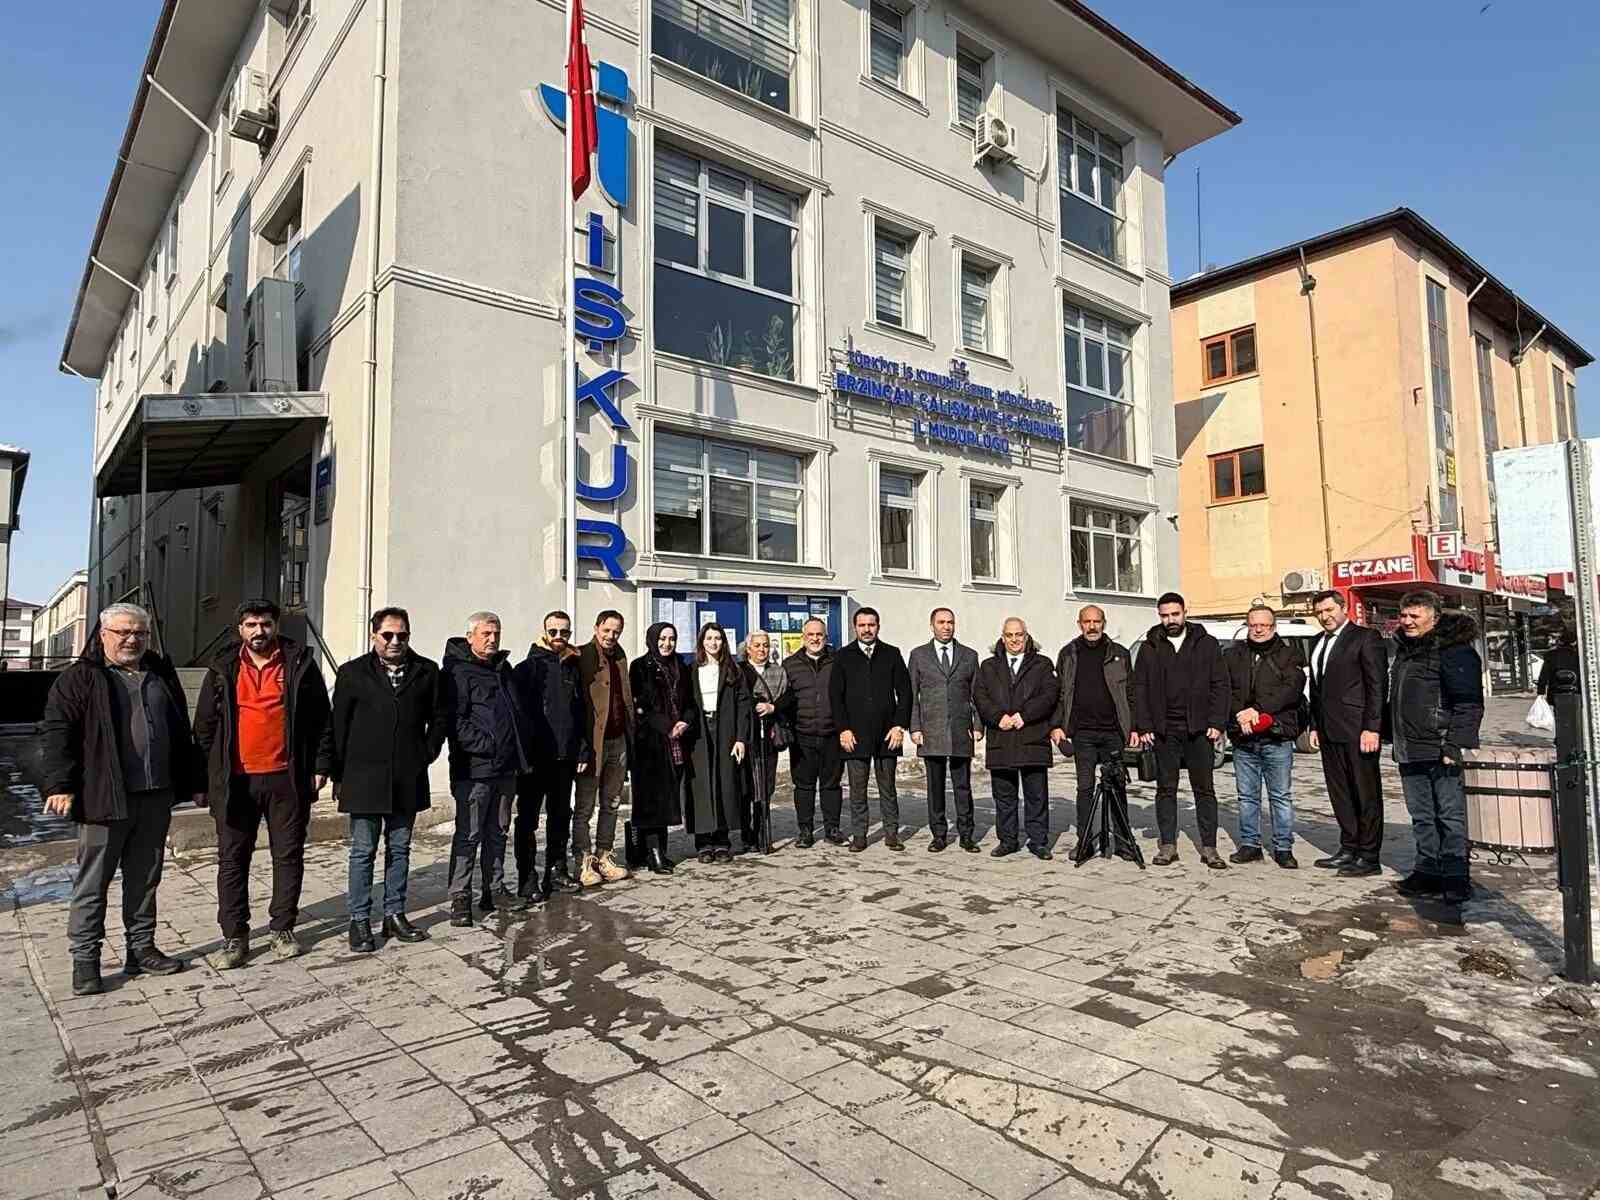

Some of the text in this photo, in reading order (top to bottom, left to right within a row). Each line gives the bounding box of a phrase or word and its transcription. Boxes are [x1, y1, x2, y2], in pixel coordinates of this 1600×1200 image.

[847, 350, 899, 377] TÜRKİYE
[916, 367, 961, 392] KURUMU
[963, 381, 994, 402] GENEL
[836, 371, 914, 408] ERZİNCAN
[919, 391, 980, 423] ÇALIŞMA
[981, 406, 1001, 427] VE
[1017, 416, 1064, 442] KURUMU
[929, 420, 1009, 454] MÜDÜRLÜĞÜ
[1437, 536, 1451, 554] E
[1337, 557, 1412, 578] ECZANE
